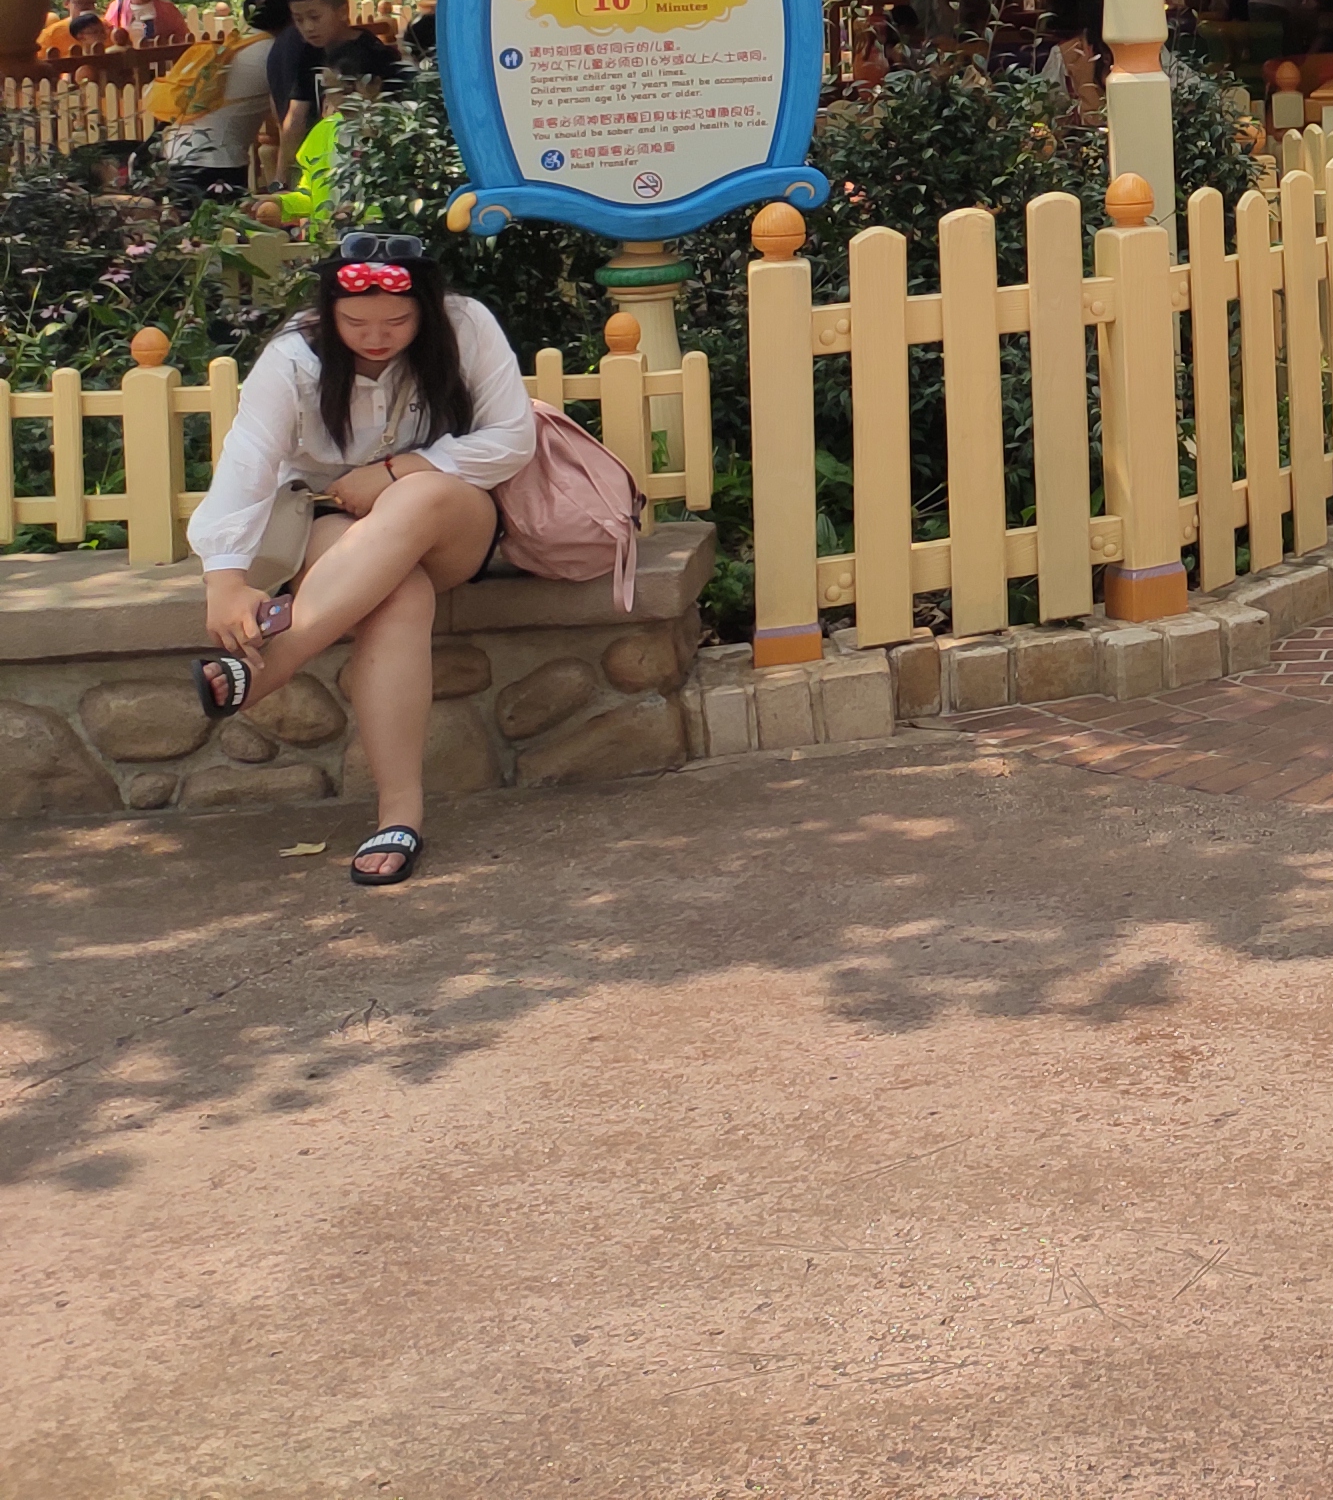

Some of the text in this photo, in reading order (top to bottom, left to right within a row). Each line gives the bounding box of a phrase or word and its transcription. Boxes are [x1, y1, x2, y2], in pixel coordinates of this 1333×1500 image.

[656, 2, 708, 13] Minutes
[530, 69, 687, 85] Supervise children at all times.
[531, 85, 572, 95] Children
[576, 83, 606, 93] under
[610, 83, 627, 92] age
[641, 80, 668, 90] years
[672, 78, 695, 87] must
[699, 77, 710, 85] be
[714, 74, 773, 86] accompanied
[531, 97, 543, 107] by
[557, 97, 591, 107] person
[595, 96, 612, 105] age
[616, 93, 627, 101] 16
[631, 92, 657, 102] years
[675, 89, 703, 98] older.
[533, 118, 768, 141] You should be sober and in good health to ride.
[570, 157, 639, 170] Must transfer
